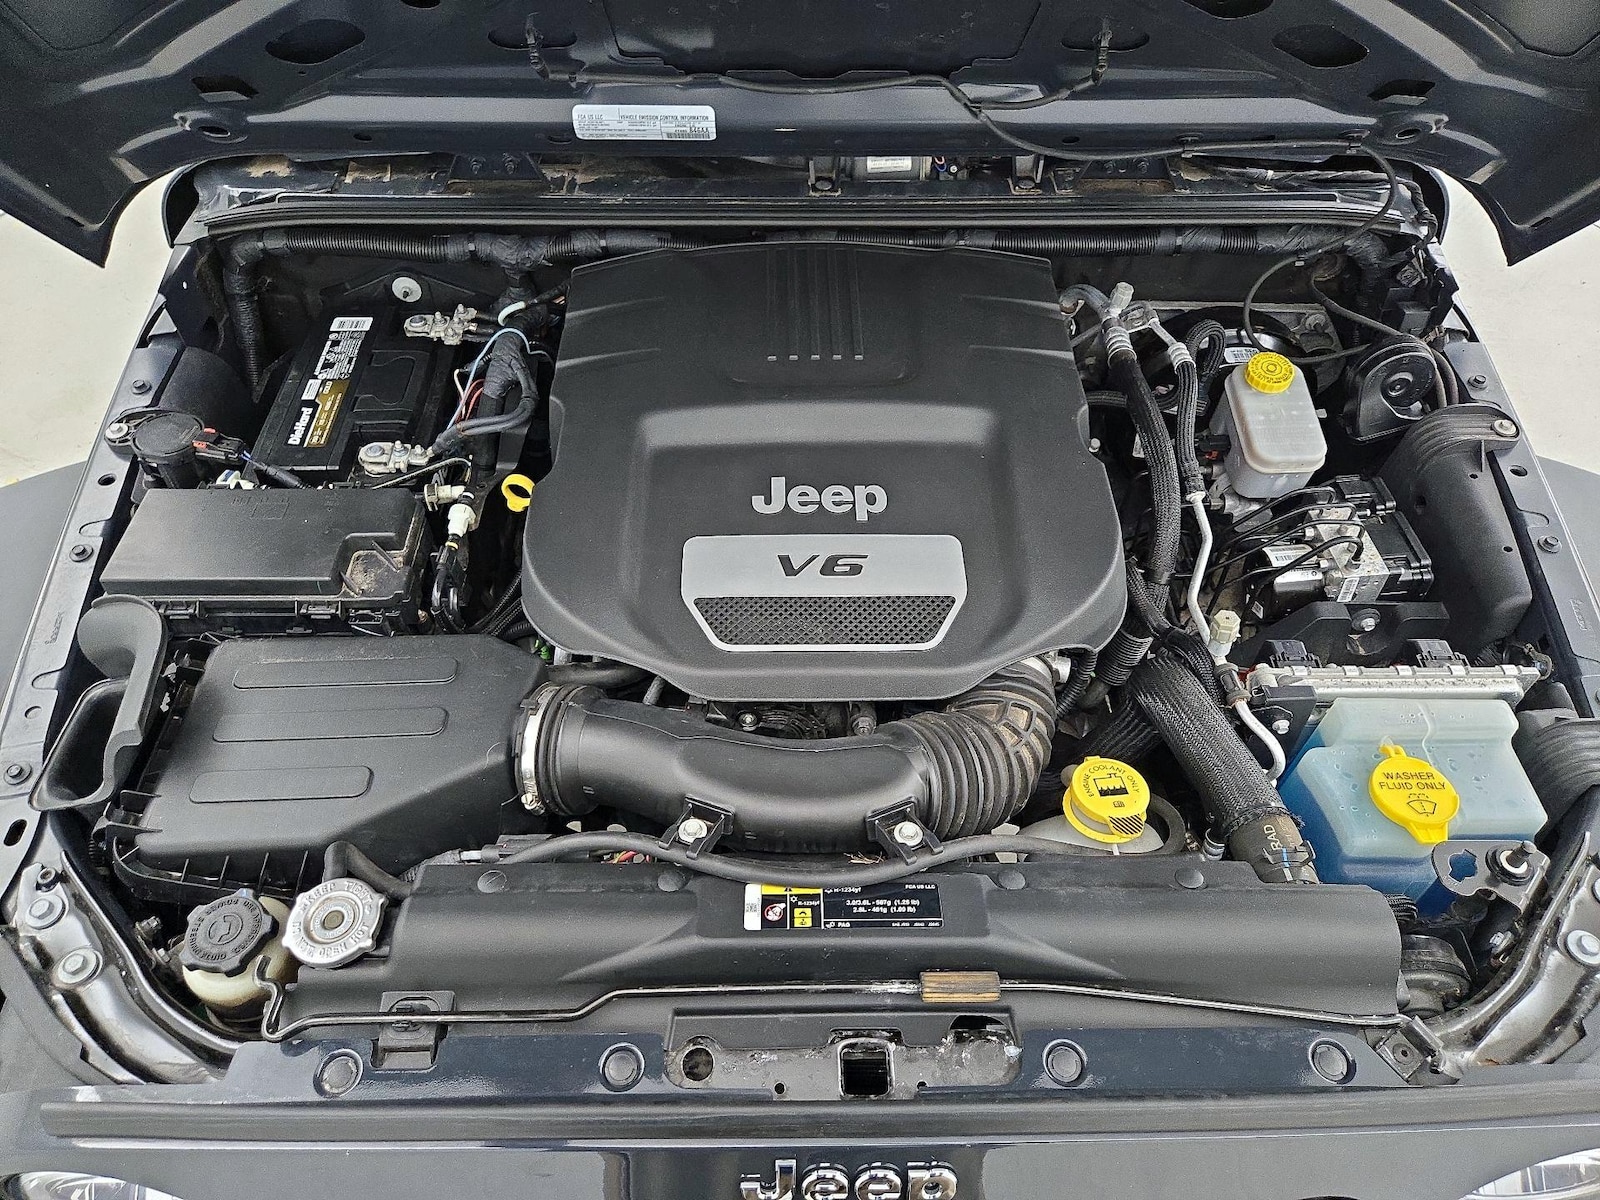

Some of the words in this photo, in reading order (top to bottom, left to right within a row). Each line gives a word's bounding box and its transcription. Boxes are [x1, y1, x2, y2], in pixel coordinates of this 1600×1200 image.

[287, 407, 314, 446] DieHard
[752, 476, 888, 521] Jeep
[777, 554, 869, 577] V6
[1082, 774, 1095, 798] ENGINE
[1089, 764, 1126, 774] COOLANT
[1127, 775, 1140, 793] ONLY
[1378, 782, 1413, 790] FLUID
[1417, 782, 1446, 790] ONLY
[1383, 772, 1435, 780] WASHER
[1264, 824, 1283, 850] RAD
[306, 882, 336, 905] KEEP
[344, 880, 374, 904] TIGHT
[189, 916, 204, 956] STEERING
[319, 942, 348, 958] OPEN
[350, 922, 369, 944] HOT
[740, 1159, 958, 1200] Jeep
